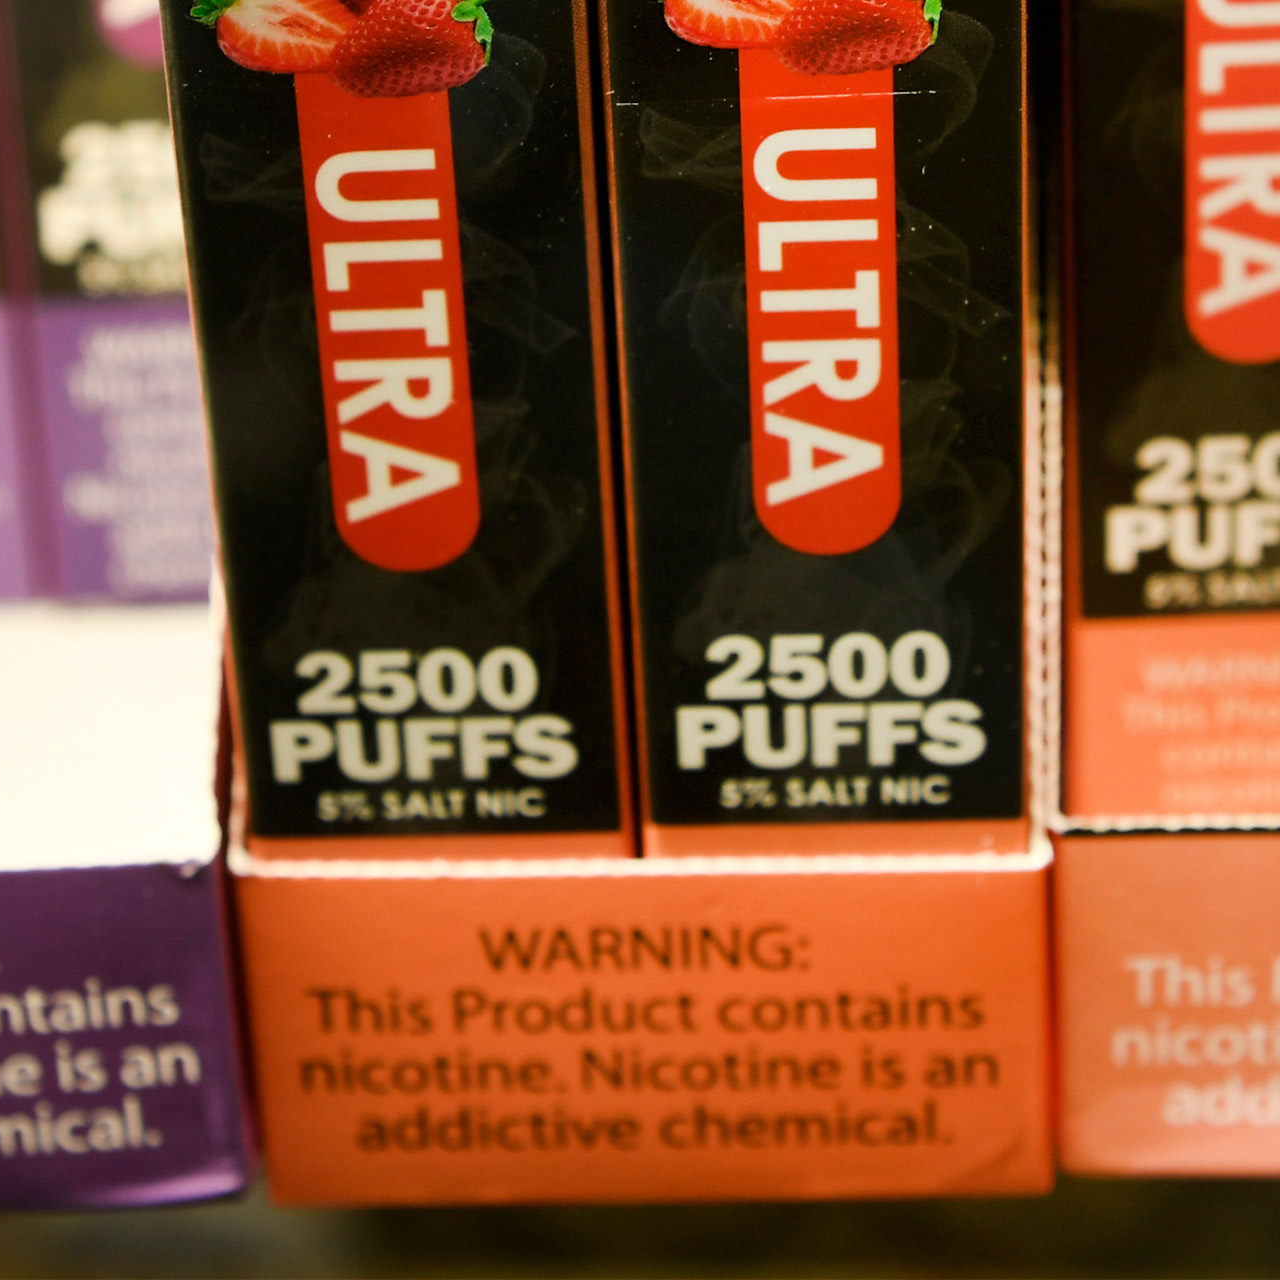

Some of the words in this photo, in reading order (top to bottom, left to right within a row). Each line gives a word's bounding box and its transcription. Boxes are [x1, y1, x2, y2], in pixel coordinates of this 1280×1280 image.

[314, 148, 461, 524] ULTRA
[752, 127, 884, 508] ULTRA
[296, 647, 538, 715] 2500
[704, 631, 950, 700] 2500
[269, 715, 579, 784] PUFFS
[676, 700, 987, 771] PUFFS
[317, 792, 373, 823] 5%
[381, 789, 466, 821] SALT
[475, 786, 546, 819] NIC
[719, 778, 775, 809] 5%
[785, 775, 869, 807] SALT
[880, 773, 951, 805] NIC
[478, 923, 811, 973] WARNING:
[1126, 956, 1254, 1008] This
[305, 987, 432, 1036] This
[453, 987, 694, 1036] Product
[716, 982, 985, 1034] contains
[55, 1040, 106, 1093] is
[120, 1041, 201, 1088] an
[298, 1049, 567, 1095] nicotine.
[580, 1048, 843, 1093] Nicotine
[861, 1043, 908, 1089] is
[925, 1048, 1000, 1089] an
[356, 1107, 642, 1154] addictive
[659, 1102, 954, 1149] chemical.
